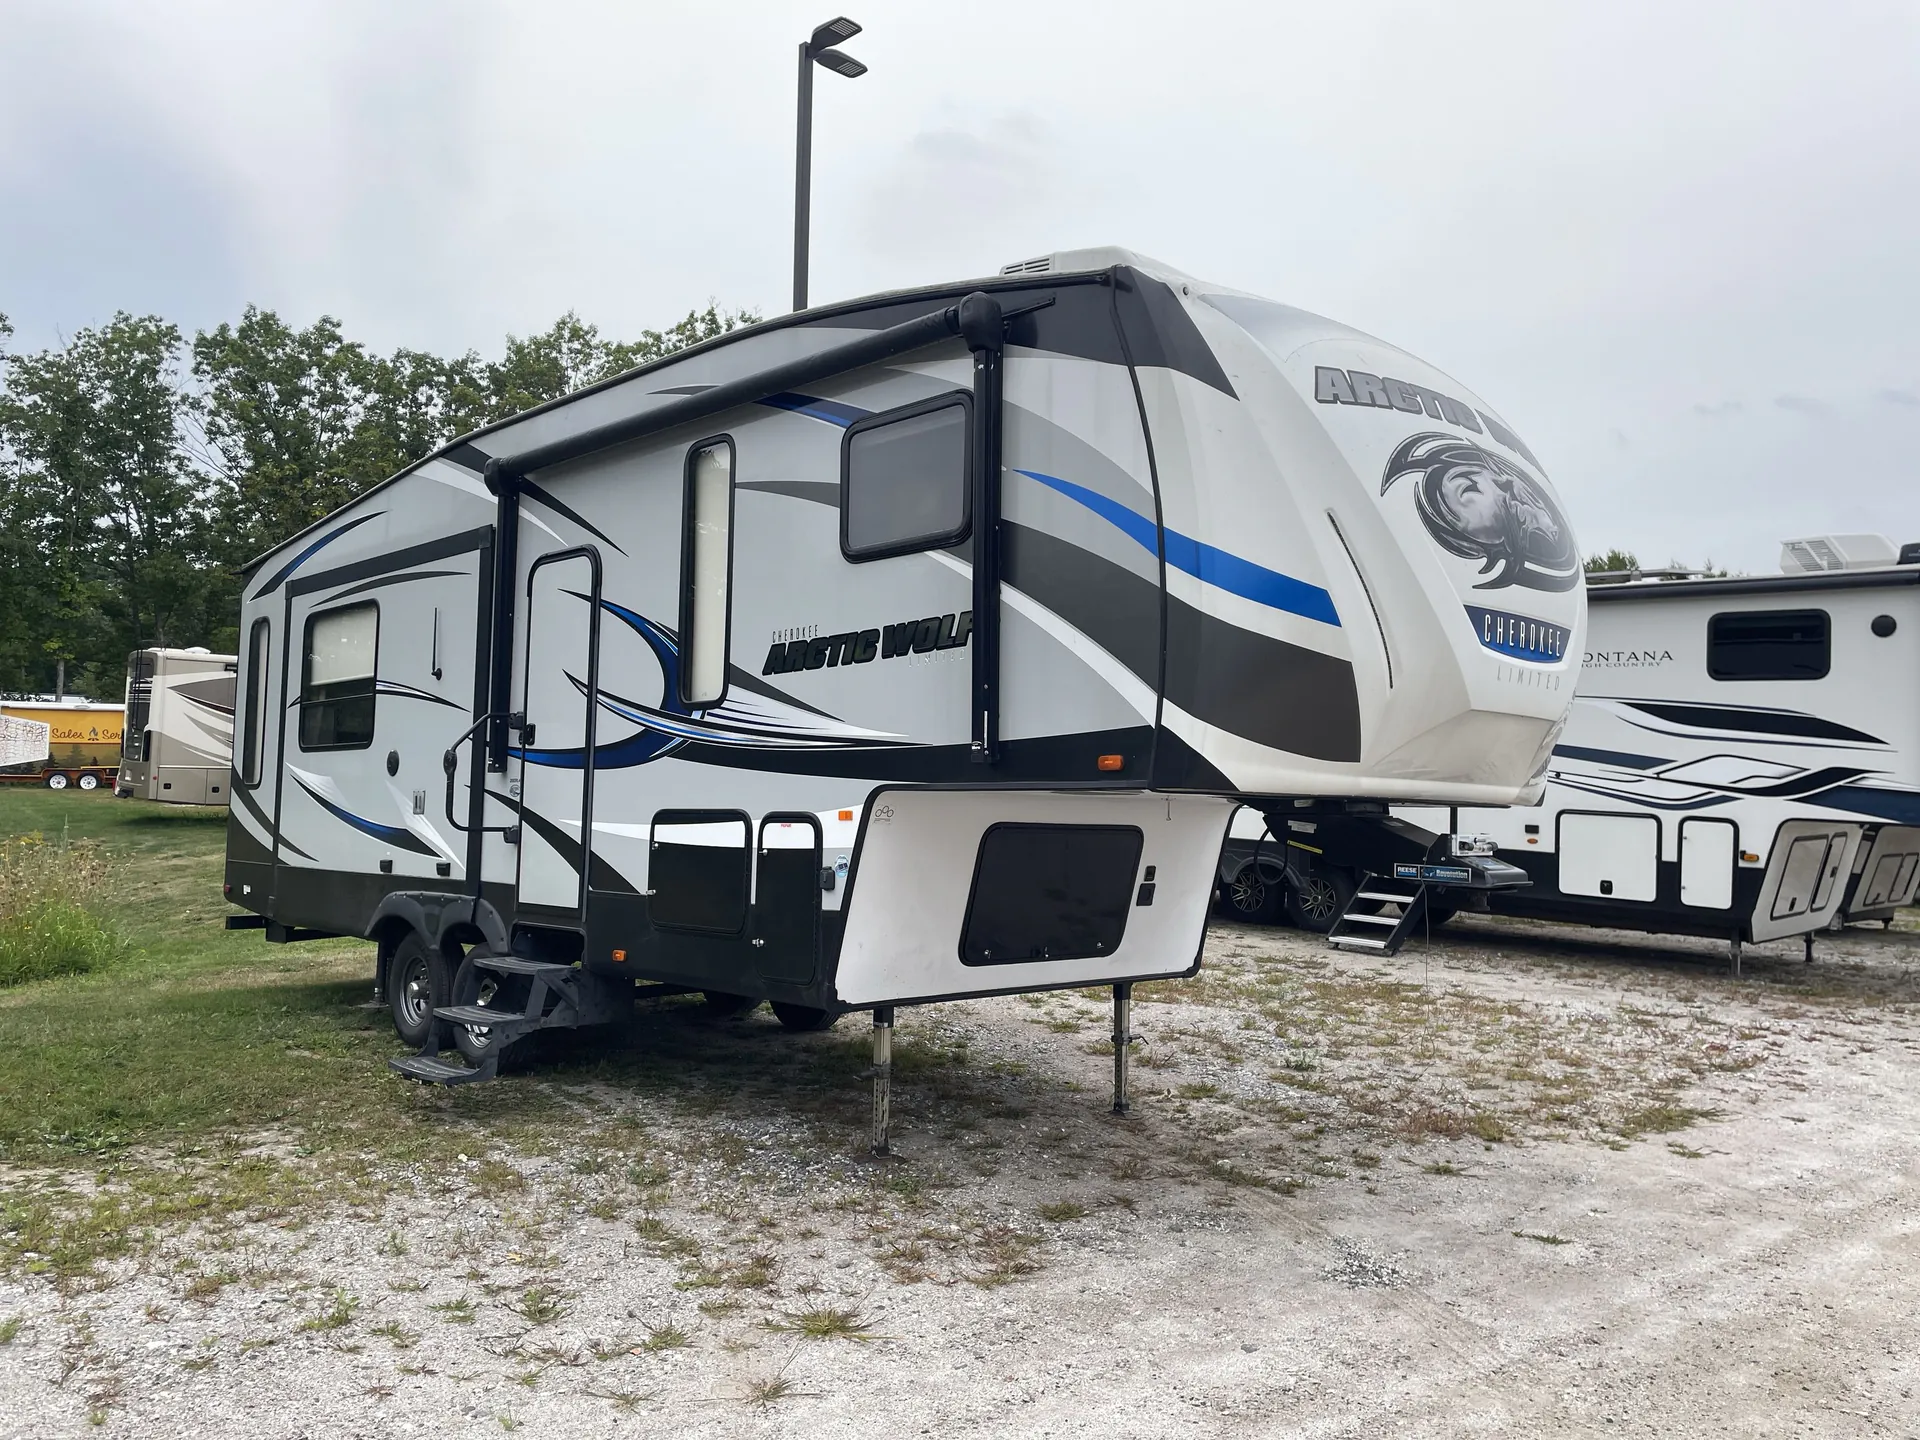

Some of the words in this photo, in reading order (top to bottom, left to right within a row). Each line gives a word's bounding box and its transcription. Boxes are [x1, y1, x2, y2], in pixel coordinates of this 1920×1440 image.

[1315, 366, 1483, 434] ARCTIC
[762, 628, 881, 676] ARCTIC
[881, 610, 973, 660] WOLF
[772, 624, 819, 643] CHEROKEE
[1484, 614, 1561, 657] CHEROKEE
[1583, 651, 1674, 662] ONTANA
[1497, 665, 1560, 691] LIMITED
[52, 728, 85, 739] Sales
[102, 729, 121, 740] Ser
